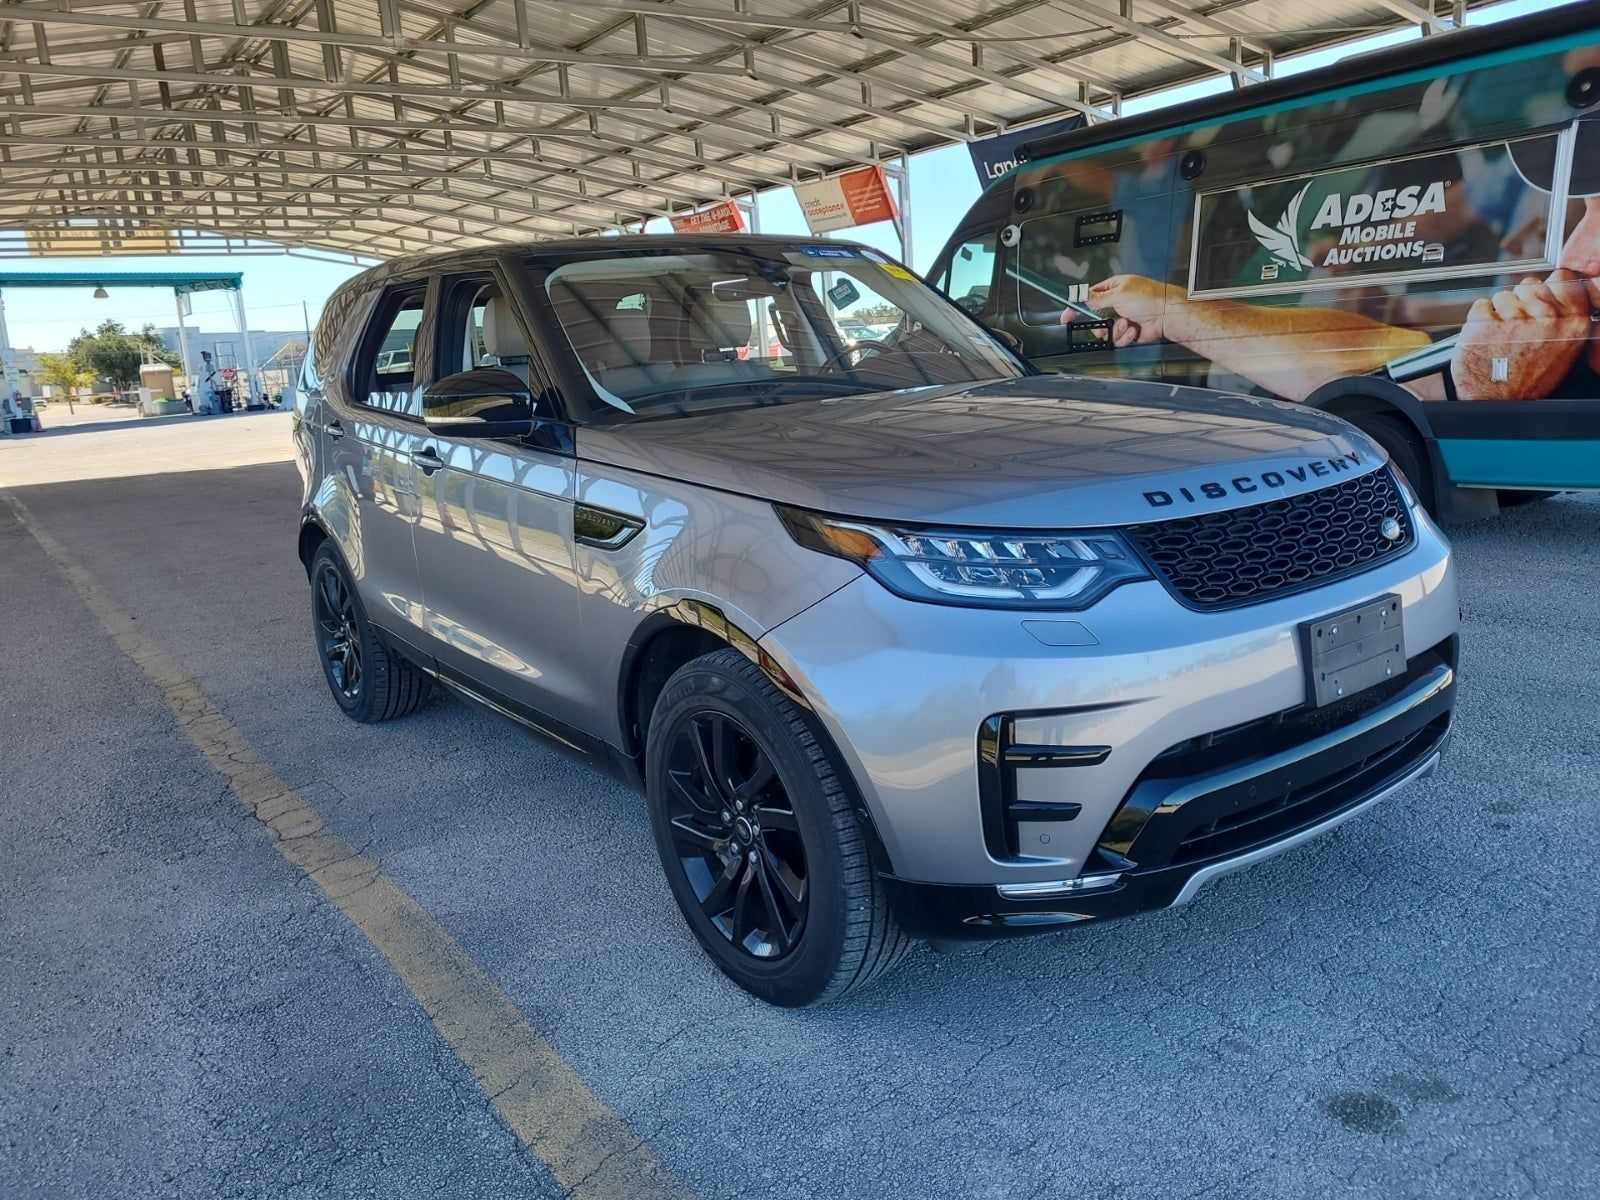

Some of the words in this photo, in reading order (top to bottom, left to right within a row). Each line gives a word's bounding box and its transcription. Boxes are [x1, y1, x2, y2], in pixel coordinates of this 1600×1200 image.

[805, 198, 821, 209] credit
[807, 201, 844, 216] acceptance
[1310, 181, 1446, 230] ADESA
[1339, 221, 1417, 246] MOBILE
[1323, 240, 1425, 267] AUCTIONS
[1142, 452, 1362, 507] DISCOVERY
